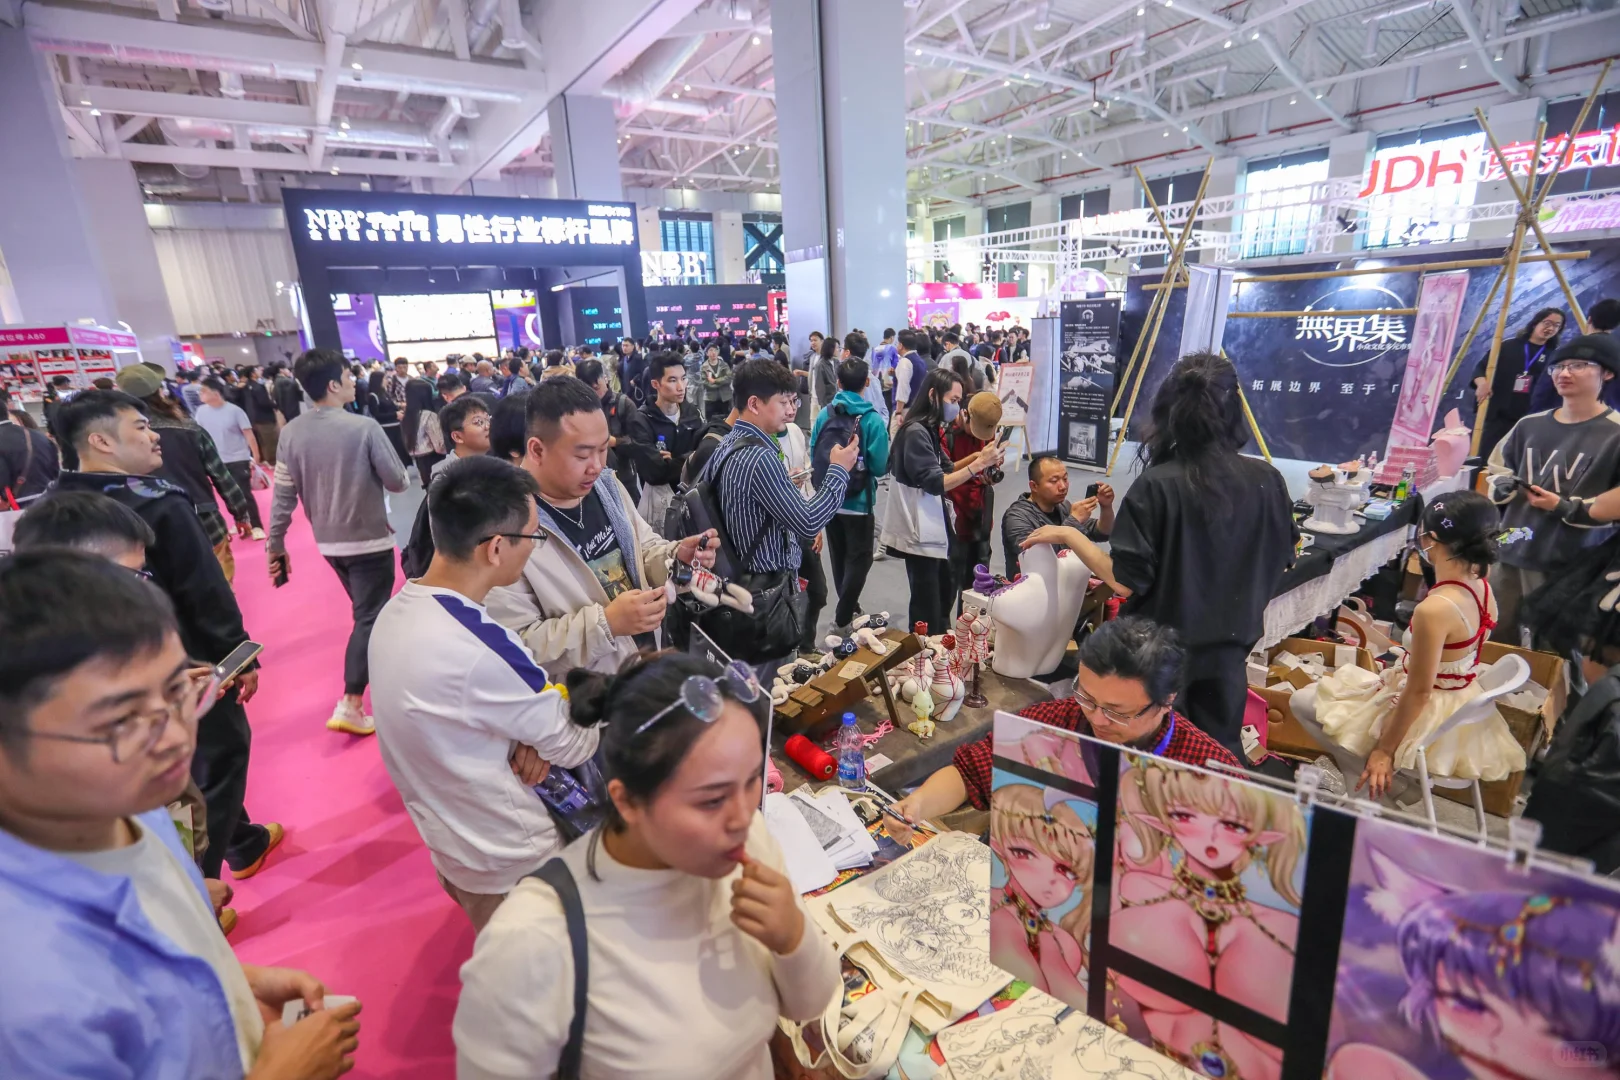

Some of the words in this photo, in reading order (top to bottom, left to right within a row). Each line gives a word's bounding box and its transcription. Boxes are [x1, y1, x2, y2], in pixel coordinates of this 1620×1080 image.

[640, 250, 707, 277] NBB
[1252, 379, 1321, 393] 拓展边界
